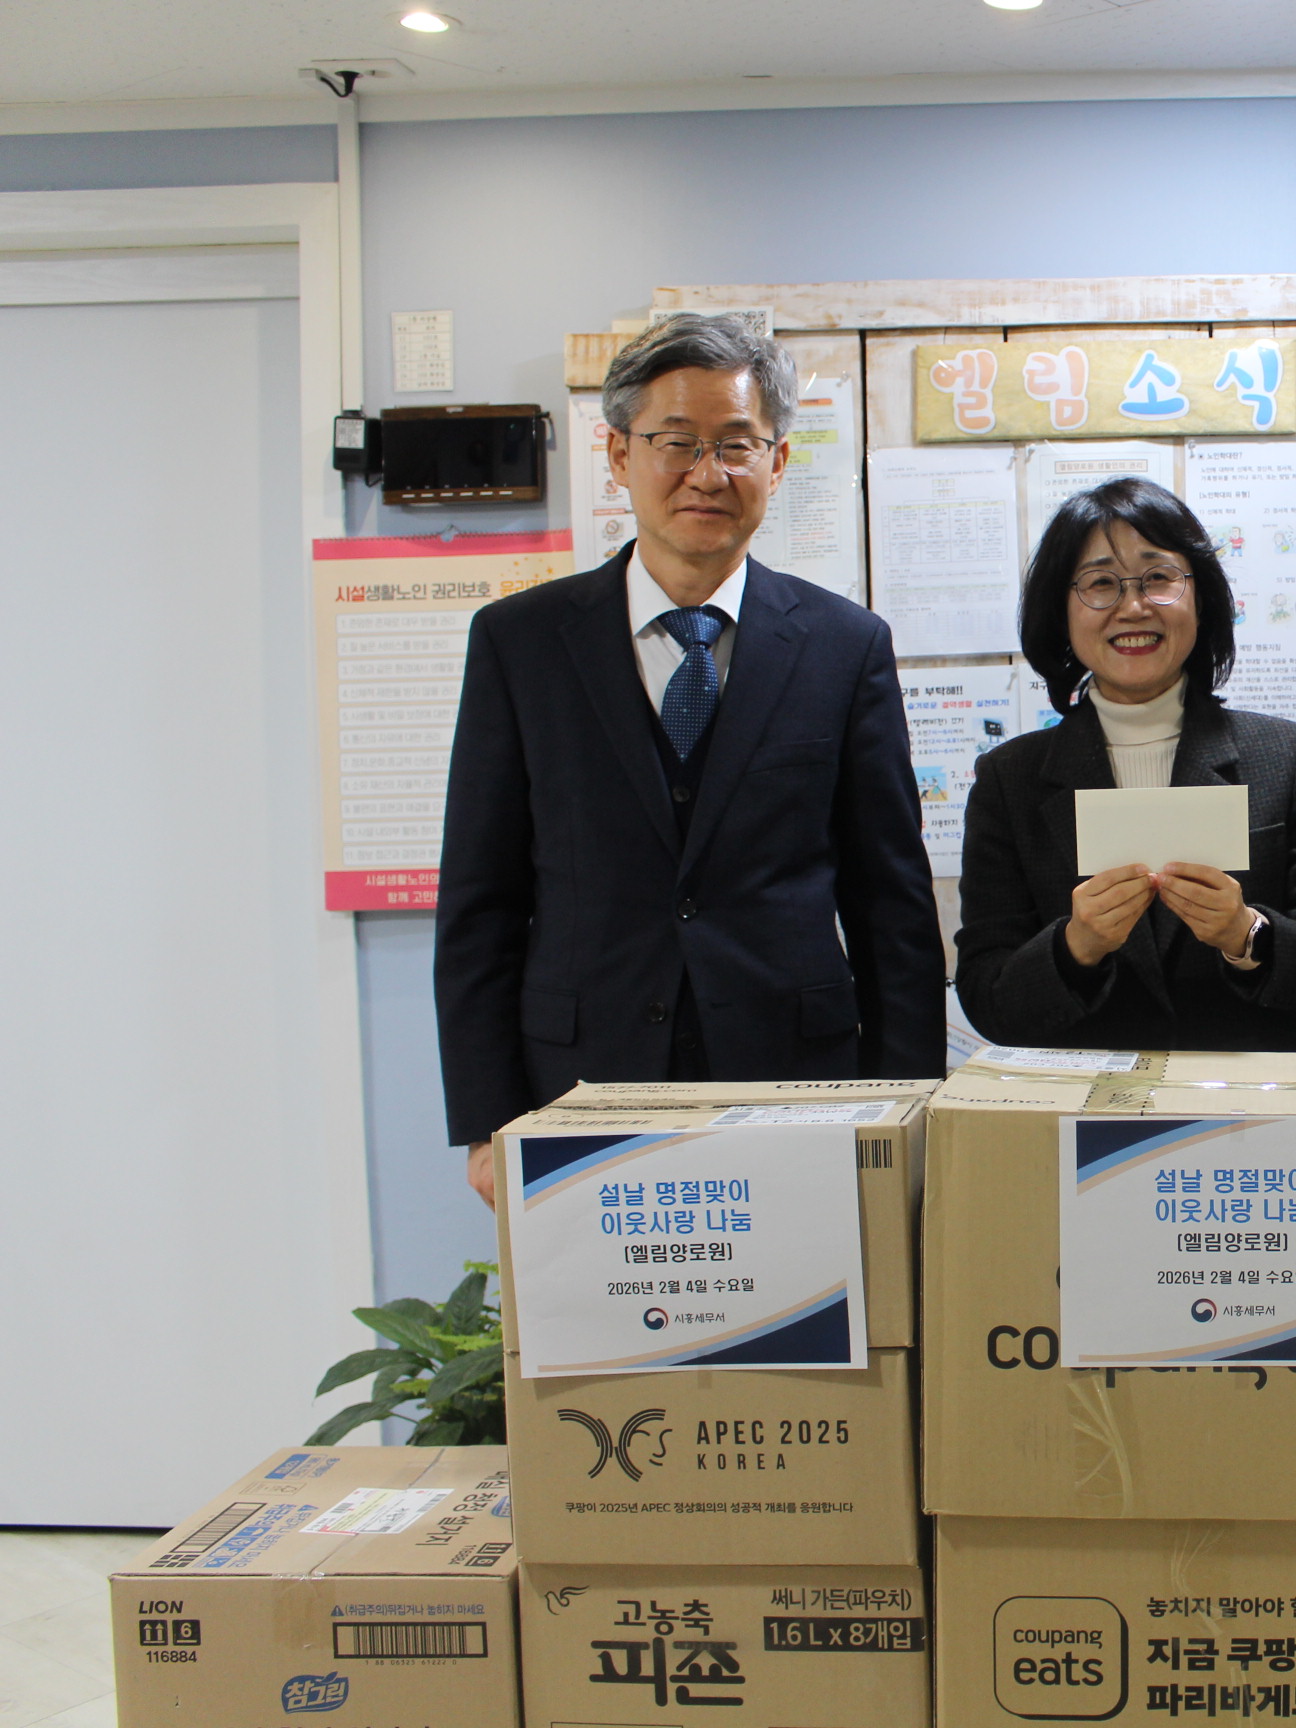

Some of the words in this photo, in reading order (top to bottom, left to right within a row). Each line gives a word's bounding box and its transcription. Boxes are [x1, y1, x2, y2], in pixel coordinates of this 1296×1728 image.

[335, 583, 427, 602] 시설생활노인
[431, 582, 492, 600] 권리보호
[925, 685, 963, 696] 부탁해!!
[776, 1081, 918, 1090] coupang
[1154, 1168, 1203, 1194] 설날
[598, 1181, 646, 1207] 설날
[656, 1179, 751, 1205] 명절맞이
[601, 1209, 697, 1236] 이웃사랑
[706, 1208, 752, 1233] 나눔
[1154, 1197, 1253, 1224] 이웃사랑
[608, 1281, 654, 1295] 2026년
[659, 1280, 681, 1294] 2월
[686, 1279, 708, 1294] 4일
[713, 1277, 755, 1292] 수요일
[1156, 1270, 1205, 1286] 2026년
[1210, 1270, 1233, 1285] 2월
[1238, 1270, 1261, 1285] 4일
[674, 1312, 726, 1325] 시흥세무서
[1222, 1304, 1276, 1317] 시흥세무서
[697, 1420, 765, 1445] APEC
[779, 1419, 850, 1445] 2025
[697, 1453, 786, 1470] KOREA
[453, 1492, 498, 1512] 청정
[565, 1502, 597, 1514] 쿠팡이
[599, 1502, 638, 1513] 2025년
[641, 1503, 671, 1513] APEC
[673, 1502, 728, 1514] 정상회의의
[730, 1502, 762, 1513] 성공적
[765, 1502, 797, 1514] 개최를
[799, 1502, 854, 1514] 응원합니다
[415, 1515, 474, 1546] 설거지
[138, 1600, 183, 1614] LION
[457, 1604, 485, 1616] 마세요
[770, 1588, 806, 1611] 써니
[810, 1587, 912, 1612] 가든(파우치)
[1146, 1596, 1213, 1619] 놓치지
[1218, 1596, 1284, 1619] 말아야
[613, 1599, 714, 1637] 고농축
[180, 1625, 192, 1639] 6
[769, 1622, 801, 1645] 1.6
[809, 1623, 822, 1645] L
[828, 1629, 842, 1645] x
[849, 1621, 912, 1650] 8개입
[1013, 1626, 1103, 1650] coupang
[146, 1650, 197, 1663] 116884
[1146, 1637, 1220, 1671] 지금
[589, 1636, 746, 1707] 피죤
[1013, 1651, 1104, 1687] eats
[285, 1678, 347, 1711] 참그린
